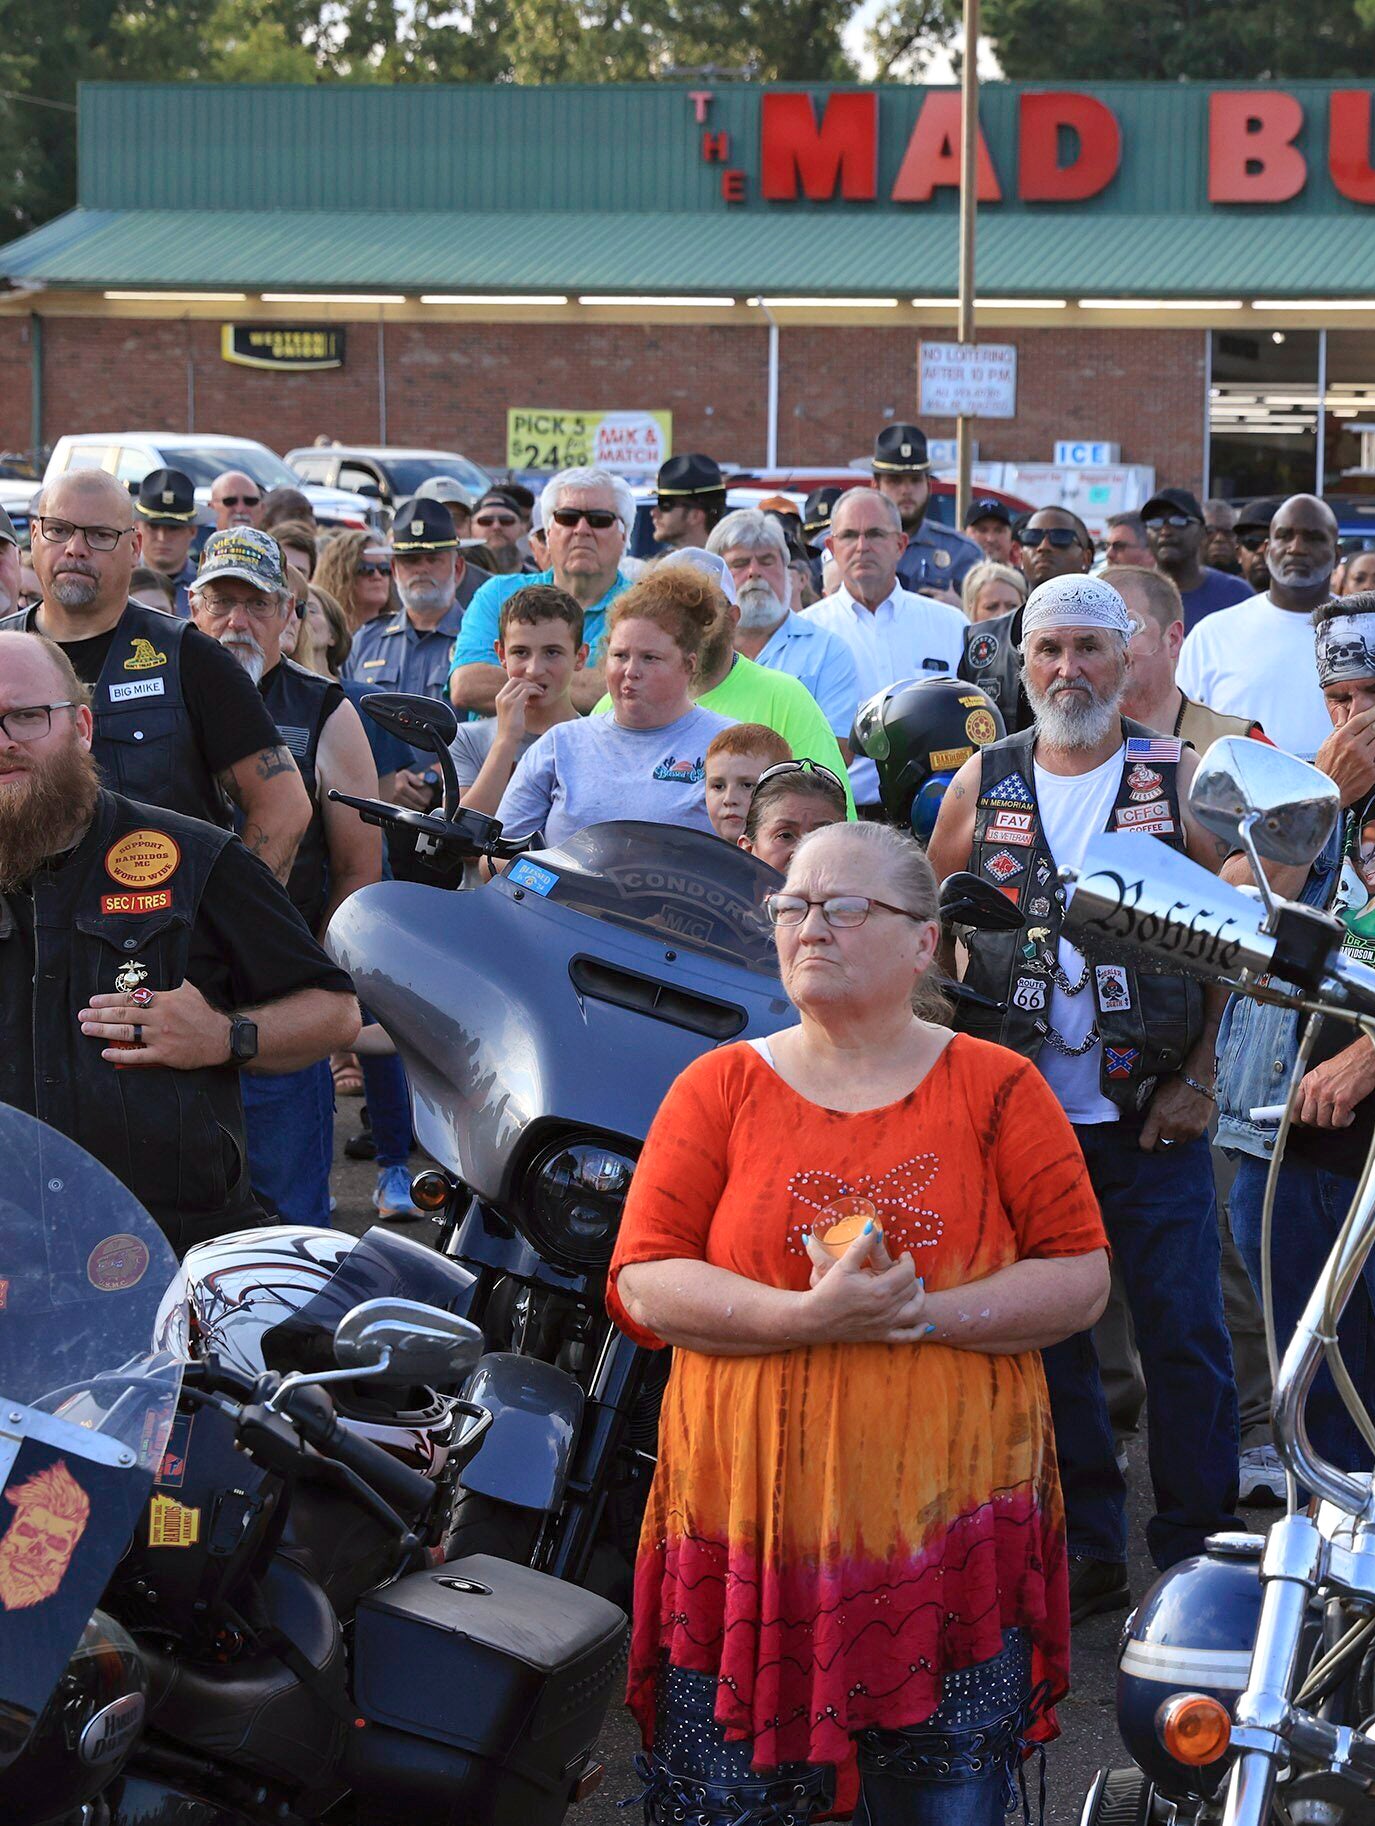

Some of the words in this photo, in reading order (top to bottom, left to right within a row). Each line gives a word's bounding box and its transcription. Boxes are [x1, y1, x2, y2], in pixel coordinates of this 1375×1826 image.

[761, 91, 1123, 202] MAD
[924, 348, 941, 360] NO
[514, 416, 565, 434] PICK
[573, 418, 586, 435] 5
[598, 450, 659, 463] MATCH
[1060, 444, 1104, 464] ICE
[114, 688, 132, 698] BIG
[134, 682, 160, 694] MIKE
[980, 797, 989, 806] IN
[990, 799, 1034, 811] MEMORIAM
[999, 814, 1028, 827] FAY
[1124, 804, 1164, 822] CFFC
[1129, 823, 1164, 832] COFFEE
[1000, 831, 1032, 843] VETERAN
[119, 840, 164, 854] SUPPORT
[115, 852, 169, 864] BANDIDOS
[114, 867, 146, 882] WORLD
[147, 863, 173, 881] WIDE
[666, 912, 706, 939] M/C
[1019, 979, 1045, 989] ROUTE
[1017, 991, 1041, 1009] 66
[163, 1505, 182, 1543] BANDIDOS
[183, 1511, 193, 1539] ARKANSAS
